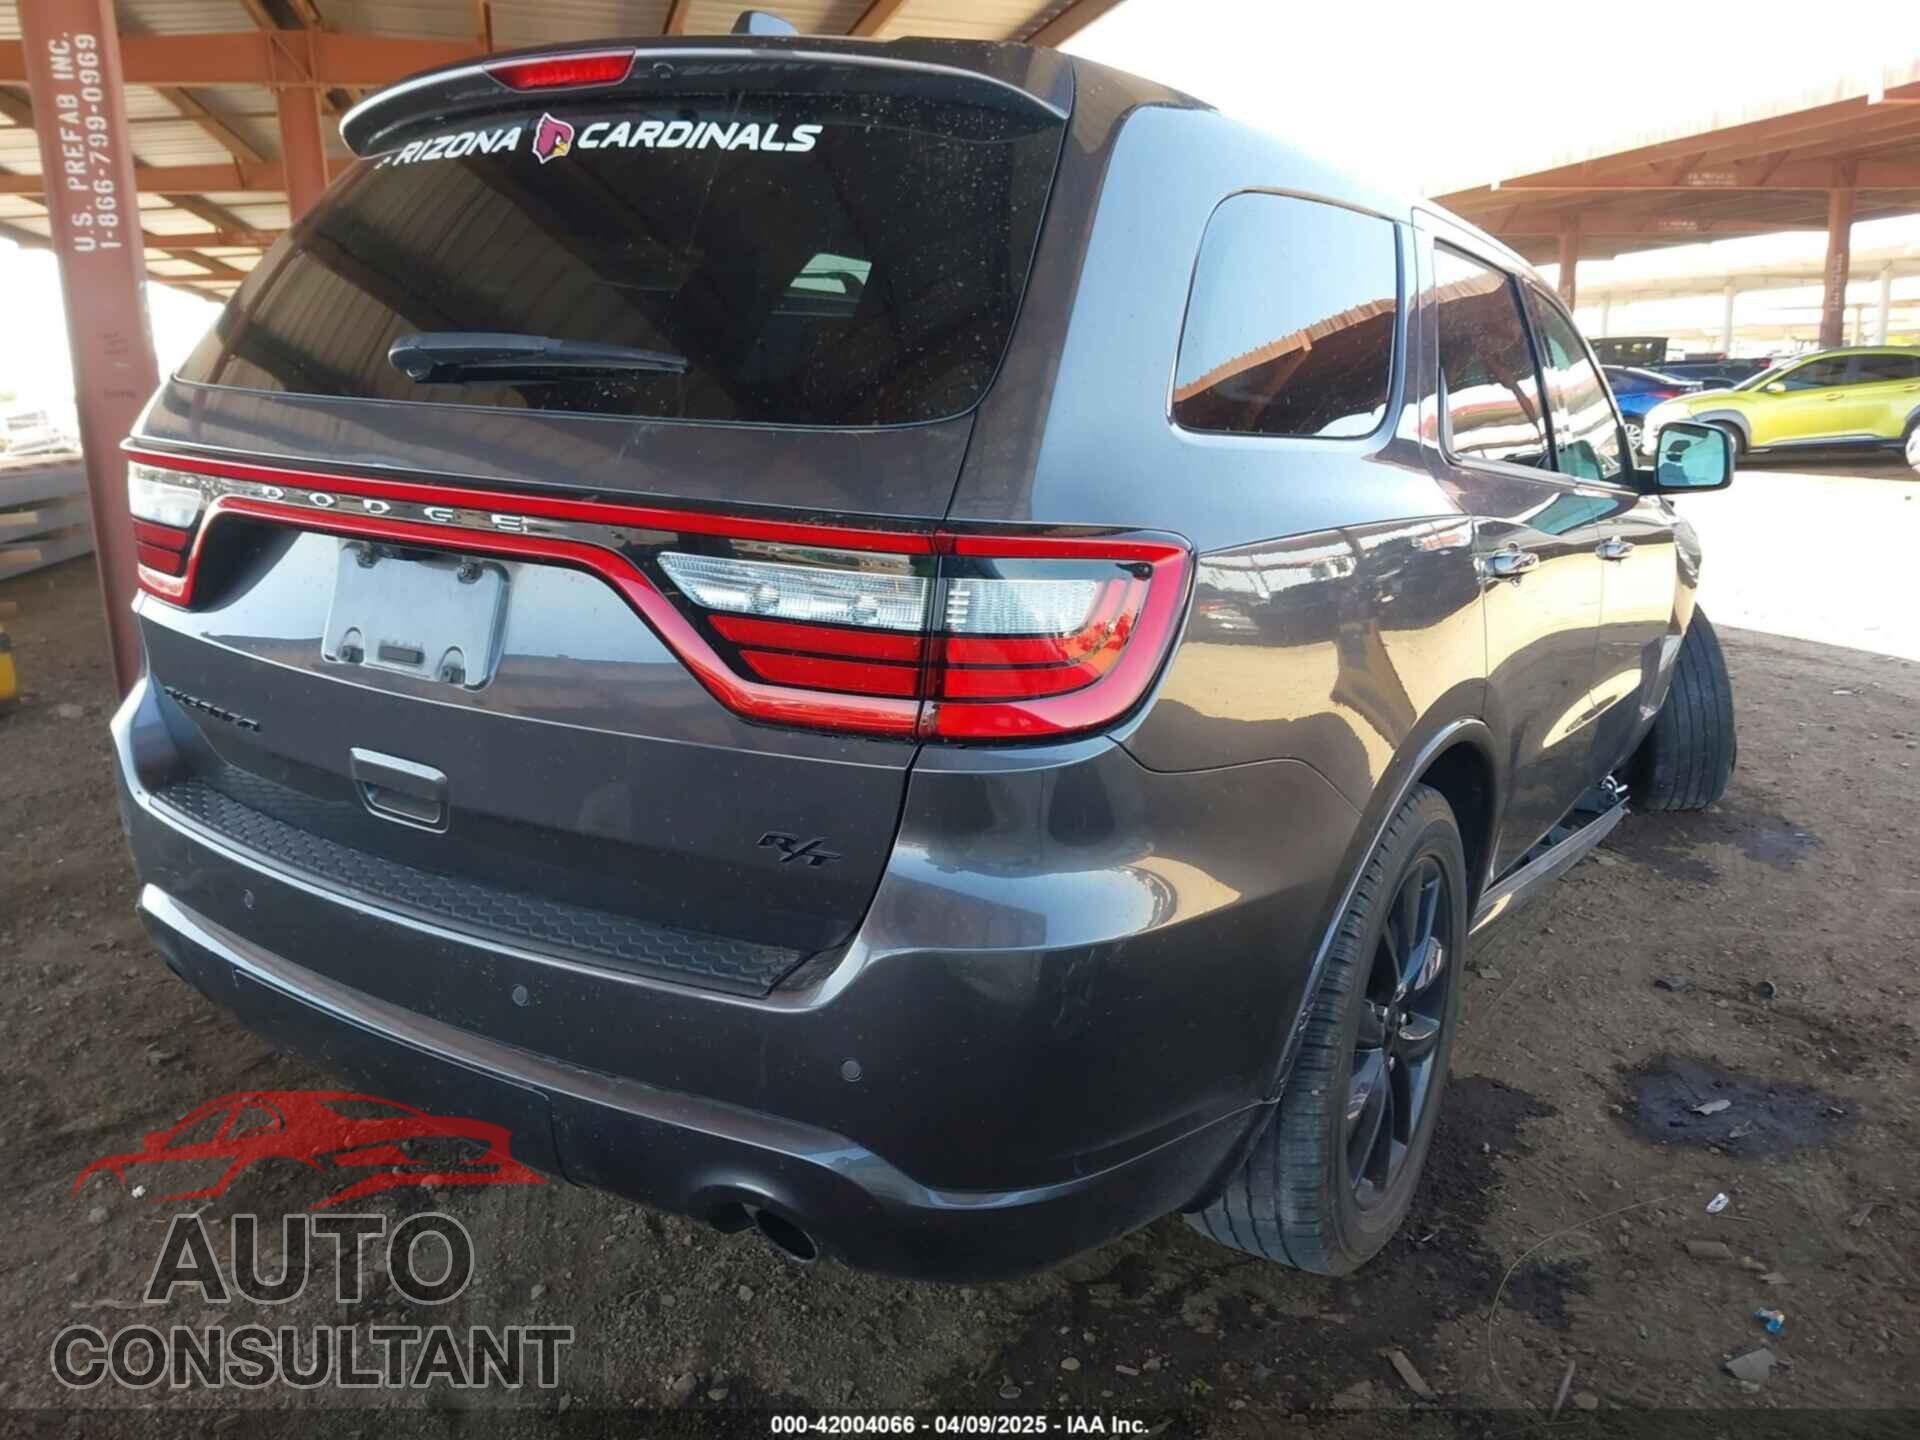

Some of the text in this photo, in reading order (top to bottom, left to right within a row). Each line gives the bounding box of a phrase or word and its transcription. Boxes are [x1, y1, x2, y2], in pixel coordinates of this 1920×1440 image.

[48, 31, 97, 252] U.S. PREFAB INC.
[74, 33, 123, 249] 1-866-799-0969
[577, 120, 823, 152] CARDINALS
[261, 485, 523, 532] DODGE
[755, 832, 843, 867] R/T
